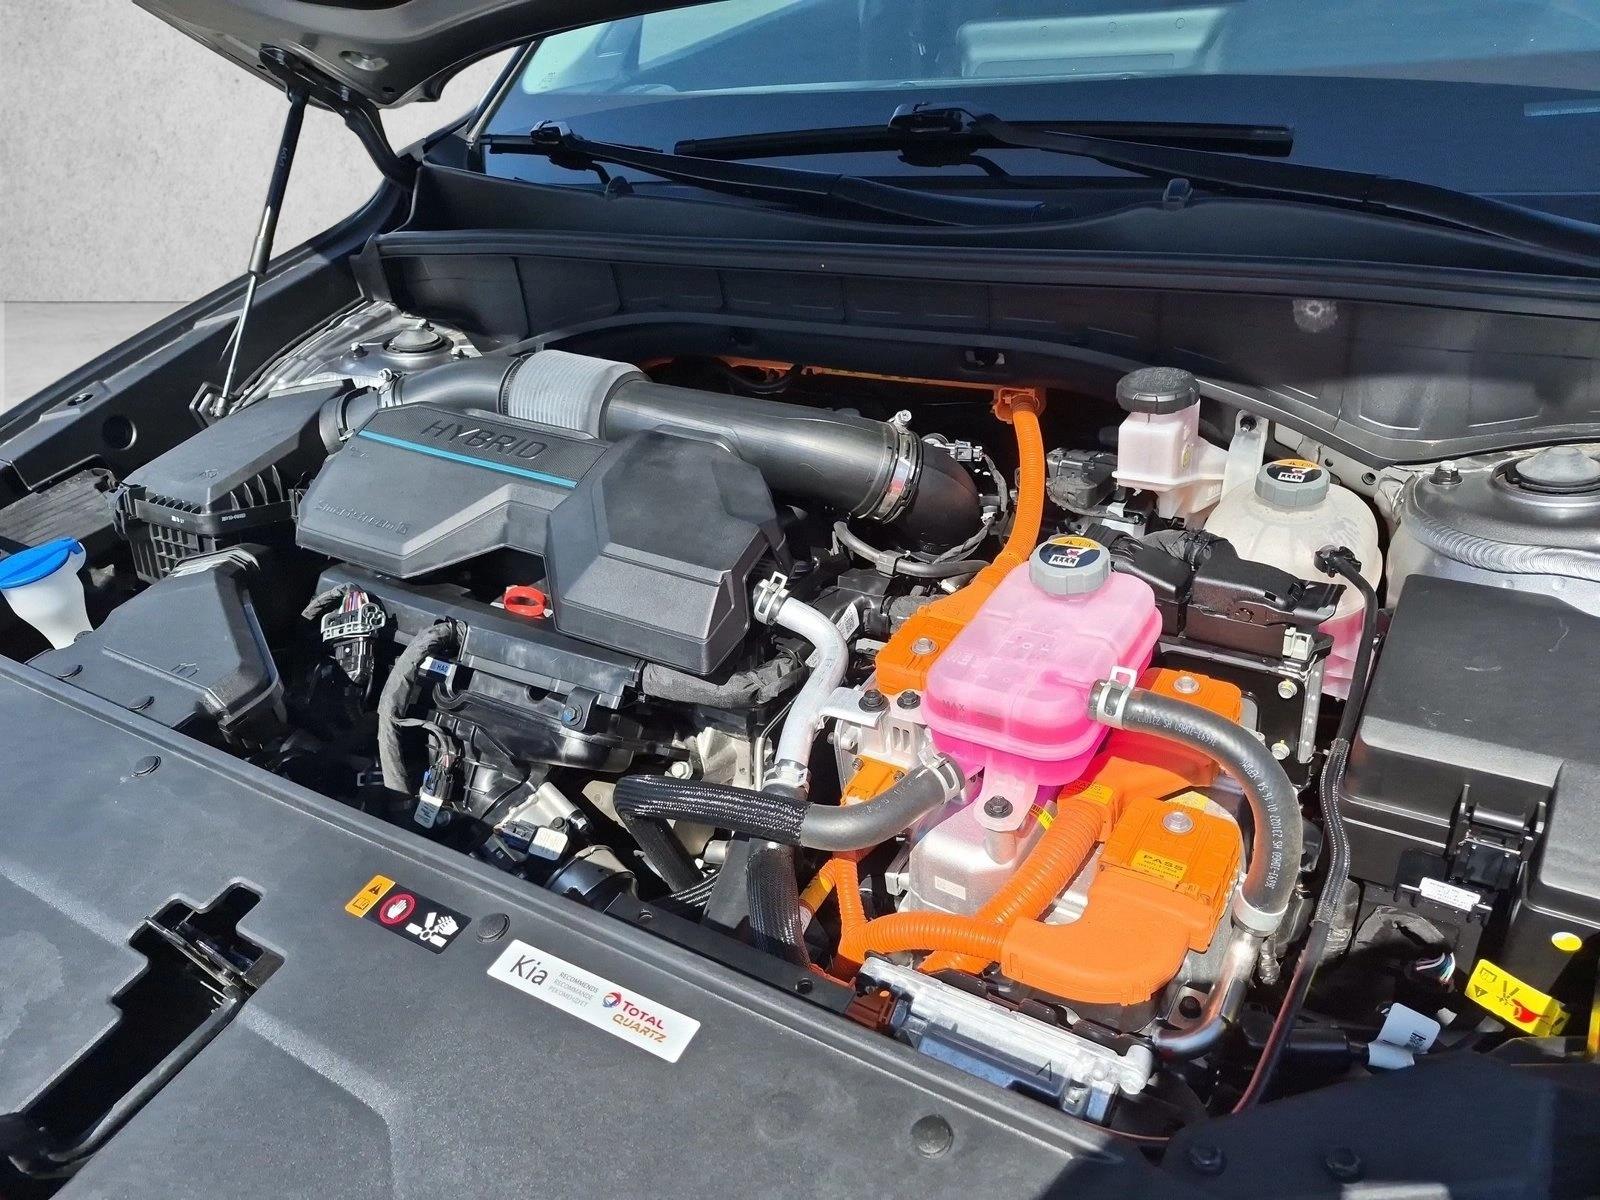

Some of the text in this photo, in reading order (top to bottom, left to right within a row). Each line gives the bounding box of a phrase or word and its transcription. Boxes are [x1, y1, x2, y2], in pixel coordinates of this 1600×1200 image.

[421, 419, 548, 460] HYBRID
[510, 954, 549, 986] Kia
[559, 971, 599, 993] RECOMMENDS
[553, 979, 594, 1001] RECOMMANDE
[612, 1013, 667, 1043] QUARTZ
[622, 1000, 664, 1030] TOTAL
